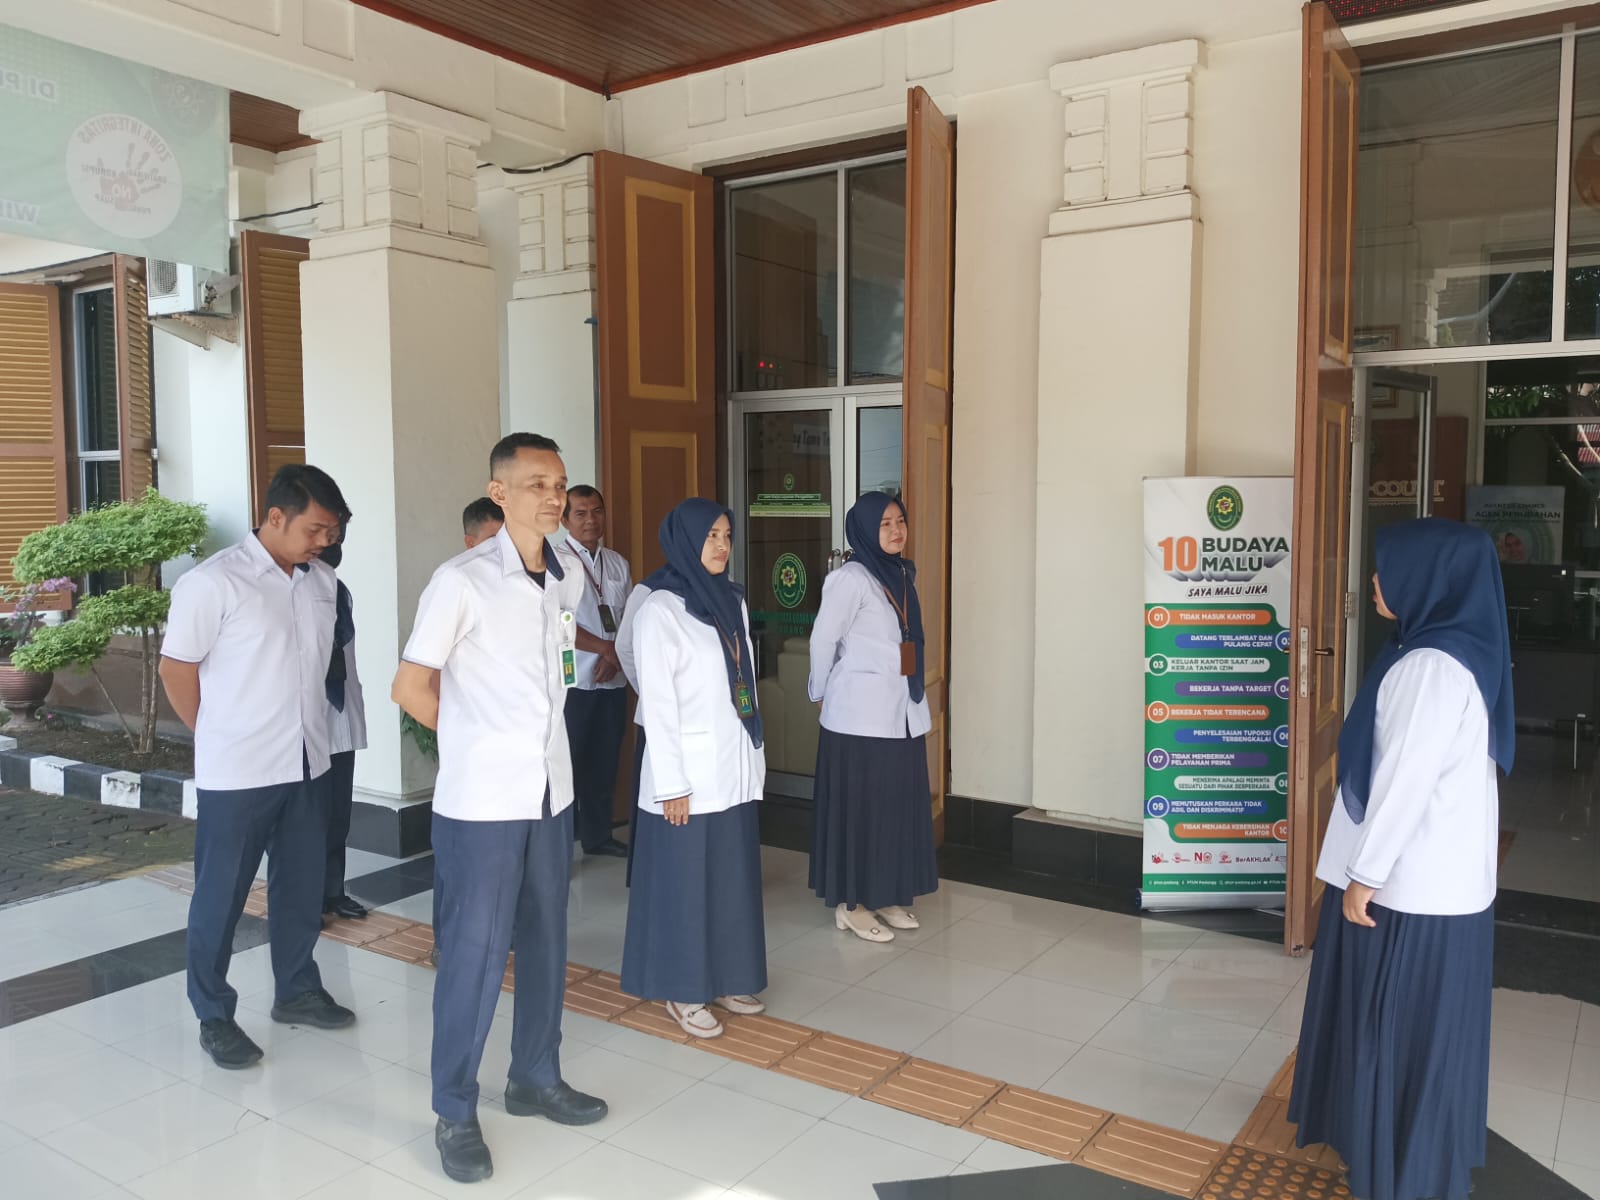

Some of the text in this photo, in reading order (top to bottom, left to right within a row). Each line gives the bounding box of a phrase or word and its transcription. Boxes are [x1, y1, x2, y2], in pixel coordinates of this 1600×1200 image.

[1202, 537, 1290, 553] BUDAYA
[1157, 535, 1198, 572] 10
[1202, 557, 1263, 572] MALU
[1188, 585, 1268, 597] SAYA MALU JIKA
[1153, 613, 1164, 622] 01
[1179, 613, 1256, 621] TIDAK MASUK KANTOR
[1152, 708, 1164, 716] 05
[1152, 755, 1164, 764] 07
[1152, 802, 1164, 811] 09
